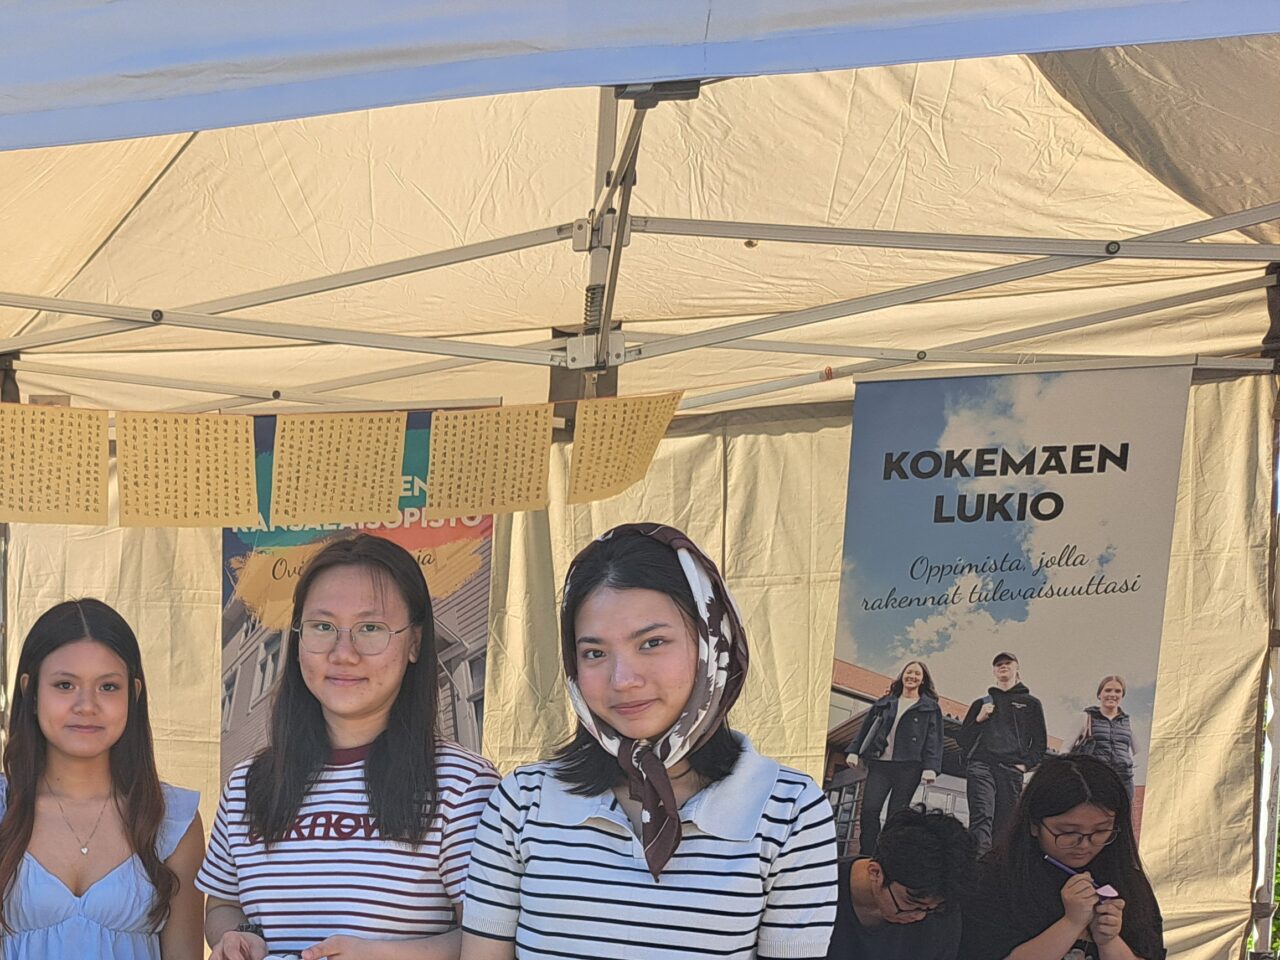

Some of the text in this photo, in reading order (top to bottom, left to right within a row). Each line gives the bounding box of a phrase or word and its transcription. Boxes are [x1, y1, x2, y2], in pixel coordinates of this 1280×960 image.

[882, 443, 1130, 481] KOKEMÄEN
[933, 491, 1064, 523] LUKIO
[1032, 544, 1090, 576] jolla
[861, 573, 1142, 612] rakennat tulevaisuuttasi
